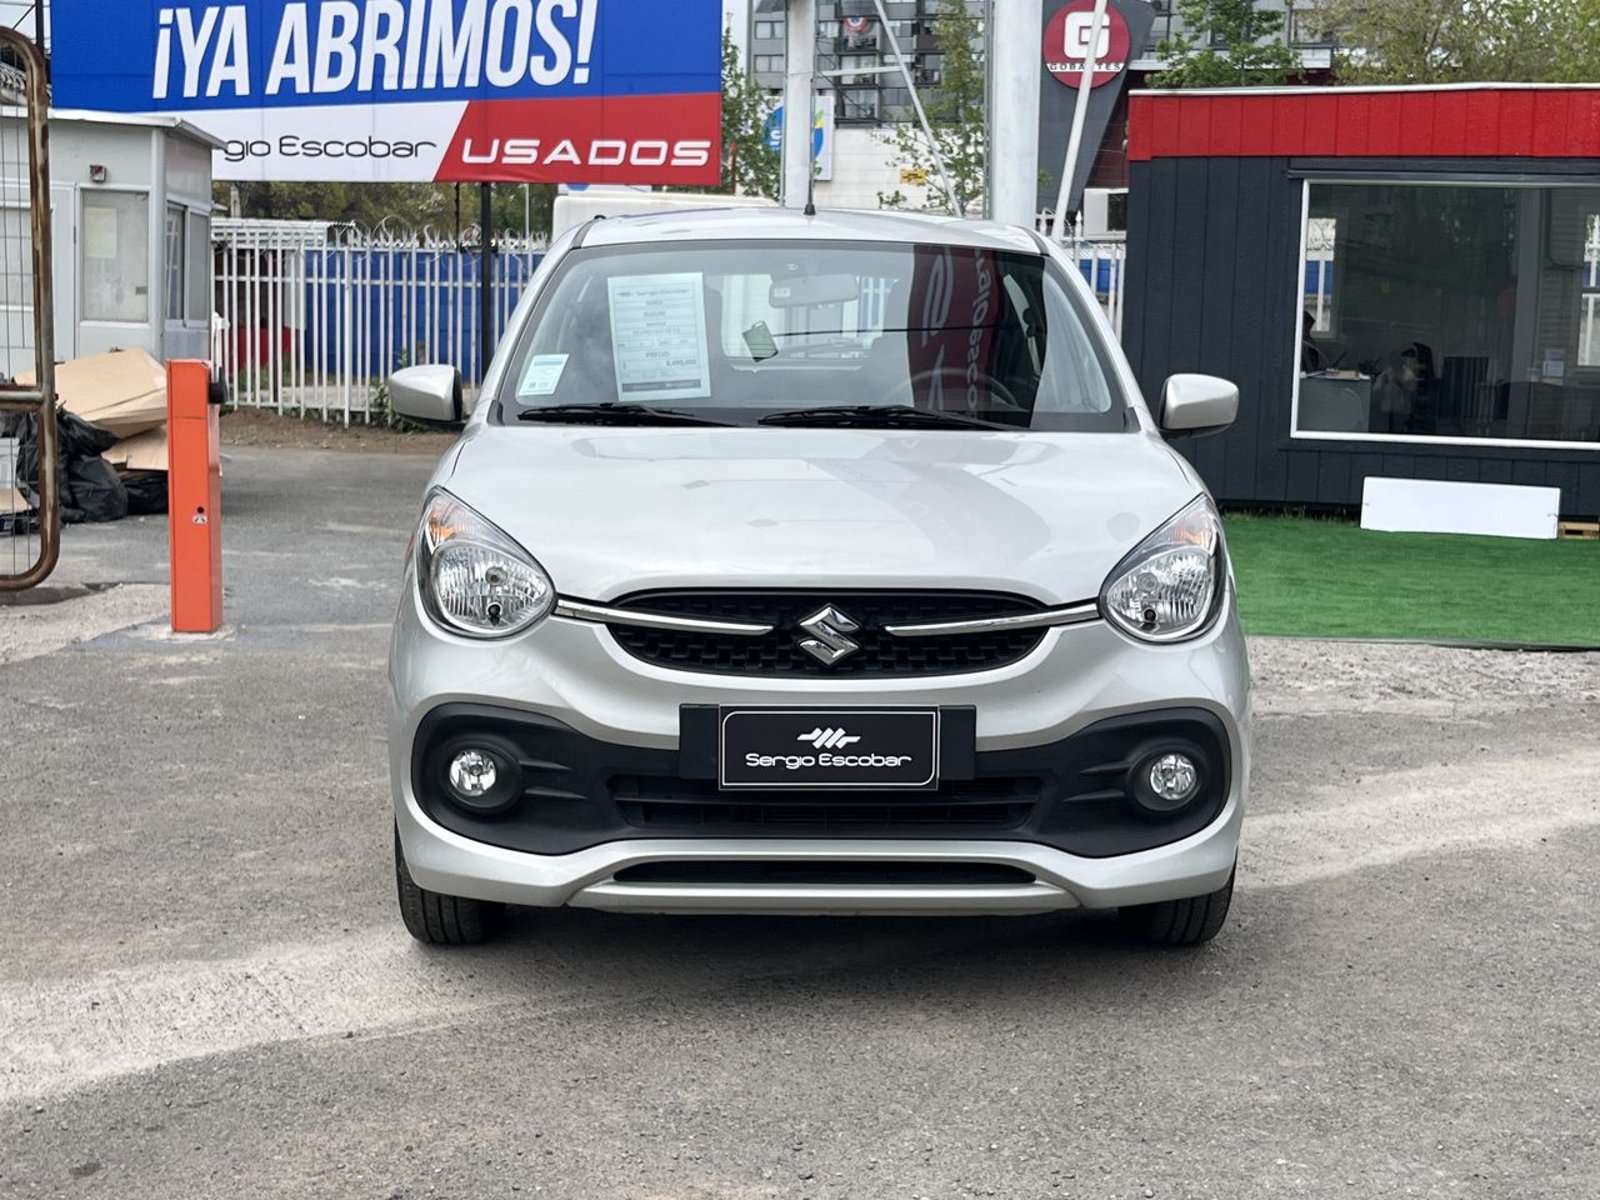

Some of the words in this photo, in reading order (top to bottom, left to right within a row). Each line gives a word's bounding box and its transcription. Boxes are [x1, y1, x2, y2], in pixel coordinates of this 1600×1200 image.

[153, 4, 250, 99] ¡YA
[265, 0, 598, 94] ABRIMOS!
[1049, 63, 1121, 71] GOBATES
[224, 140, 271, 162] gio
[279, 135, 437, 158] Escobar
[461, 138, 712, 166] USADOS
[745, 753, 815, 770] Sergio
[818, 753, 912, 767] Escobar
